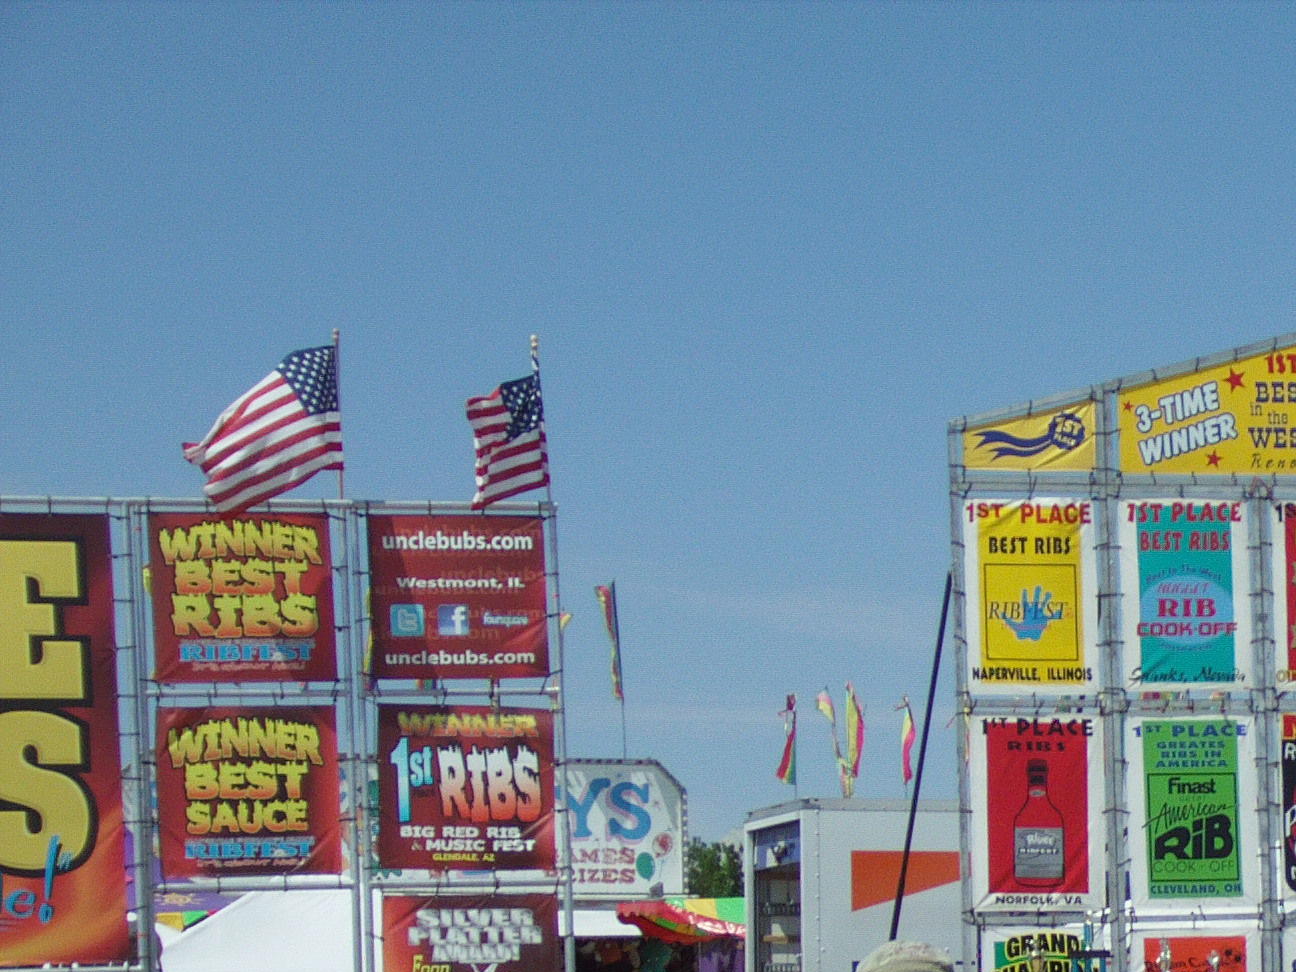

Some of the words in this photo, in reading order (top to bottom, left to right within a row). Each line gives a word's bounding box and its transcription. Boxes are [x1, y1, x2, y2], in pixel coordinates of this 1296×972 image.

[1136, 381, 1220, 433] 3-TIME
[1250, 402, 1263, 416] in
[1267, 409, 1288, 425] the
[1138, 412, 1237, 465] WINNER
[966, 503, 1002, 523] 1ST
[1021, 503, 1092, 524] PLACE
[1127, 503, 1163, 523] 1ST
[1172, 503, 1241, 522] PLACE
[159, 519, 323, 565] WINNER
[382, 530, 533, 550] unclebubs.com
[989, 537, 1027, 553] BEST
[1035, 537, 1071, 554] RIBS
[1140, 531, 1182, 550] BEST
[1189, 531, 1229, 551] RIBS
[175, 558, 308, 595] BEST
[396, 576, 503, 590] Westmont,
[508, 577, 525, 589] IL
[171, 593, 319, 638] RIBS
[1157, 598, 1216, 617] RIB
[1137, 621, 1238, 637] COOK-OFF
[385, 650, 535, 665] unclebubs.com
[972, 667, 1040, 681] NAPERVILLE,
[1047, 667, 1092, 681] ILLINOIS
[398, 711, 538, 737] WINNER
[982, 717, 1008, 735] 1ST
[1017, 718, 1093, 736] PLACE
[1132, 725, 1161, 737] 1ST
[1172, 724, 1247, 737] PLACE
[168, 717, 323, 768] WINNER
[1156, 759, 1228, 768] AMERICA
[1161, 750, 1198, 759] RIBS
[1204, 750, 1222, 758] IN
[185, 760, 308, 800] BEST
[390, 737, 433, 823] 1st
[437, 745, 541, 823] RIBS
[1168, 777, 1216, 795] Finast
[186, 799, 308, 834] SAUCE
[1142, 801, 1233, 833] American
[400, 825, 434, 838] BIG
[442, 825, 479, 838] RED
[487, 825, 521, 838] RIB
[426, 839, 485, 851] MUSIC
[493, 839, 536, 851] FEST
[483, 853, 495, 861] AZ
[558, 848, 635, 865] AMES
[1150, 884, 1219, 895] CLEVELAND,
[1225, 884, 1241, 893] OH
[995, 895, 1058, 905] NORFOLK,
[1064, 896, 1082, 904] VA
[416, 908, 535, 928] SILVER
[407, 927, 543, 945] PLATTER
[1006, 933, 1080, 959] GRAND
